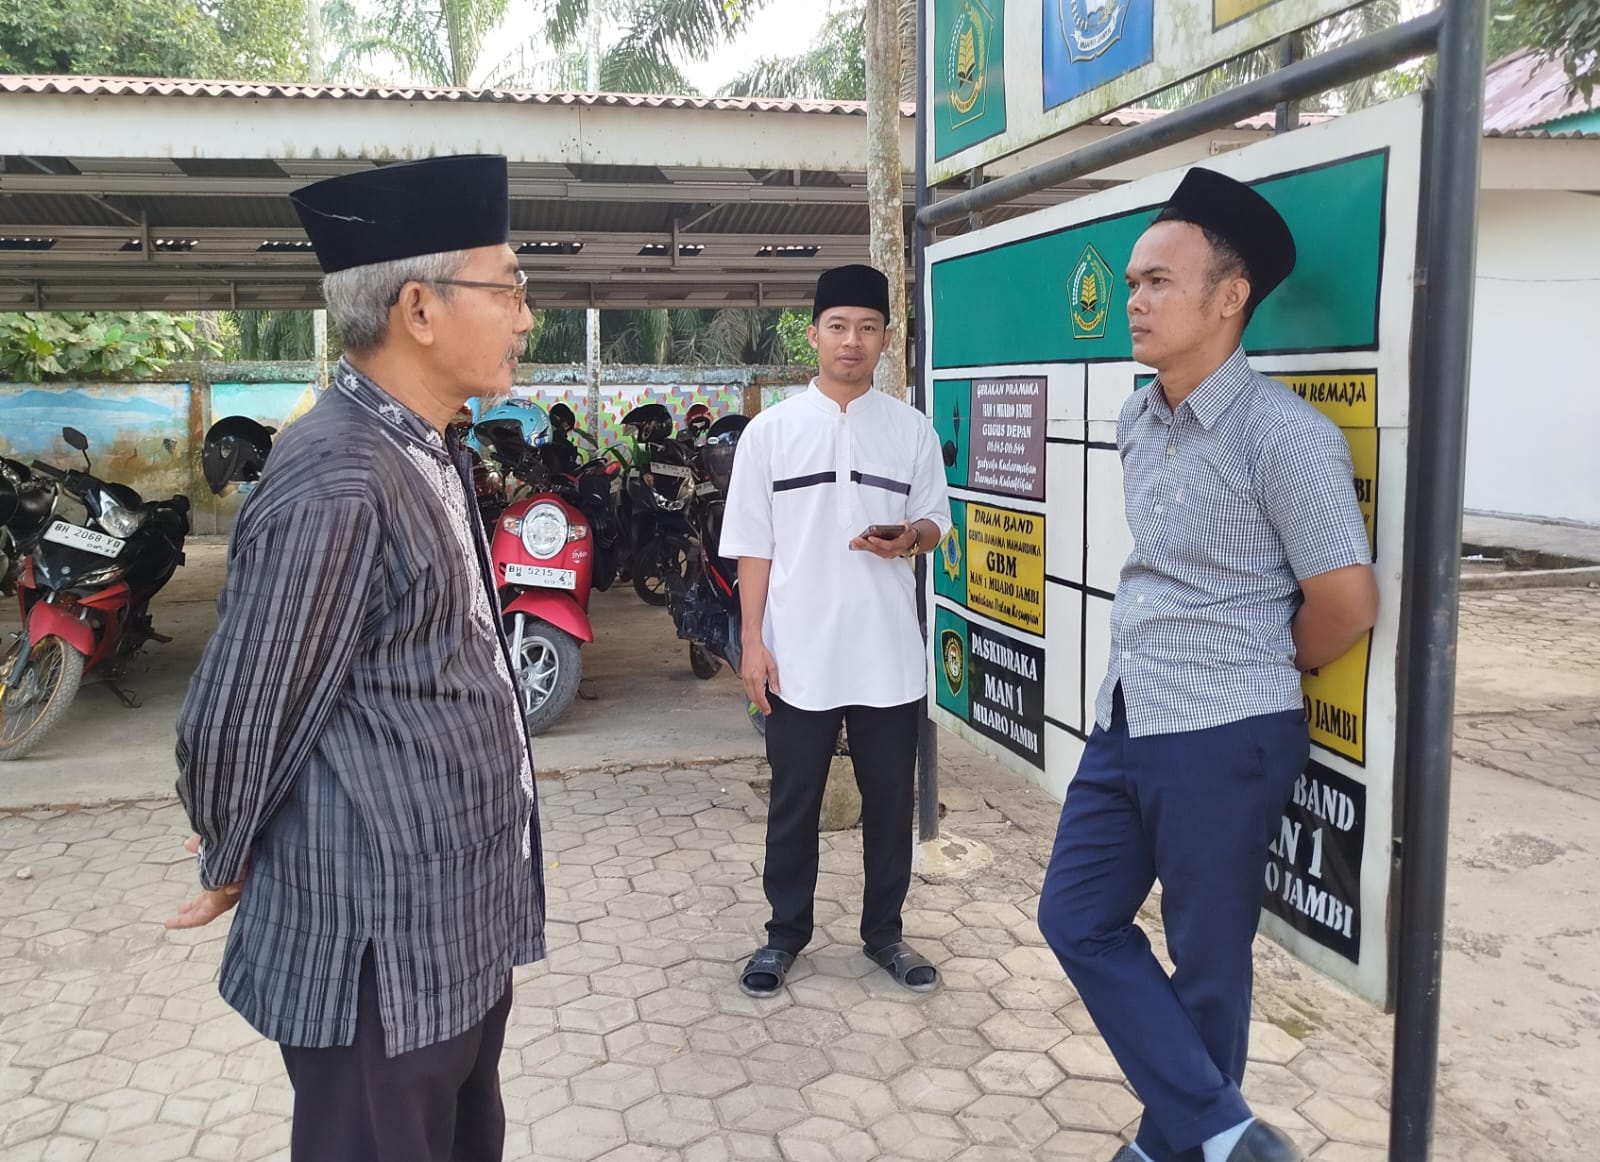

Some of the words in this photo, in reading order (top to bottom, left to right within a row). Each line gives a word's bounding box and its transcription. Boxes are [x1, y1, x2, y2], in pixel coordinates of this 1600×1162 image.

[976, 384, 1004, 398] GERAKAN
[1005, 383, 1039, 396] PRAMUKA
[1309, 381, 1367, 407] REMAJA
[982, 423, 1005, 437] GUGUS
[1006, 424, 1032, 438] DEPAN
[54, 523, 70, 533] BH
[74, 529, 102, 543] 2068
[974, 508, 1001, 529] DRUM
[1003, 515, 1034, 535] BAND
[508, 565, 522, 573] BH
[528, 567, 553, 576] 5215
[986, 550, 1017, 578] GBM
[989, 576, 1014, 597] MUARO
[1015, 585, 1039, 605] JAMBI
[971, 631, 1038, 682] PASKIBRAKA
[984, 672, 1014, 711] MAN
[1016, 685, 1024, 717] 1
[973, 700, 1009, 735] MUARO
[1010, 719, 1038, 754] JAMBI
[1315, 698, 1357, 745] JAMBI
[1293, 773, 1355, 832] BAND
[1307, 827, 1323, 879] 1
[1282, 870, 1354, 938] JAMBI
